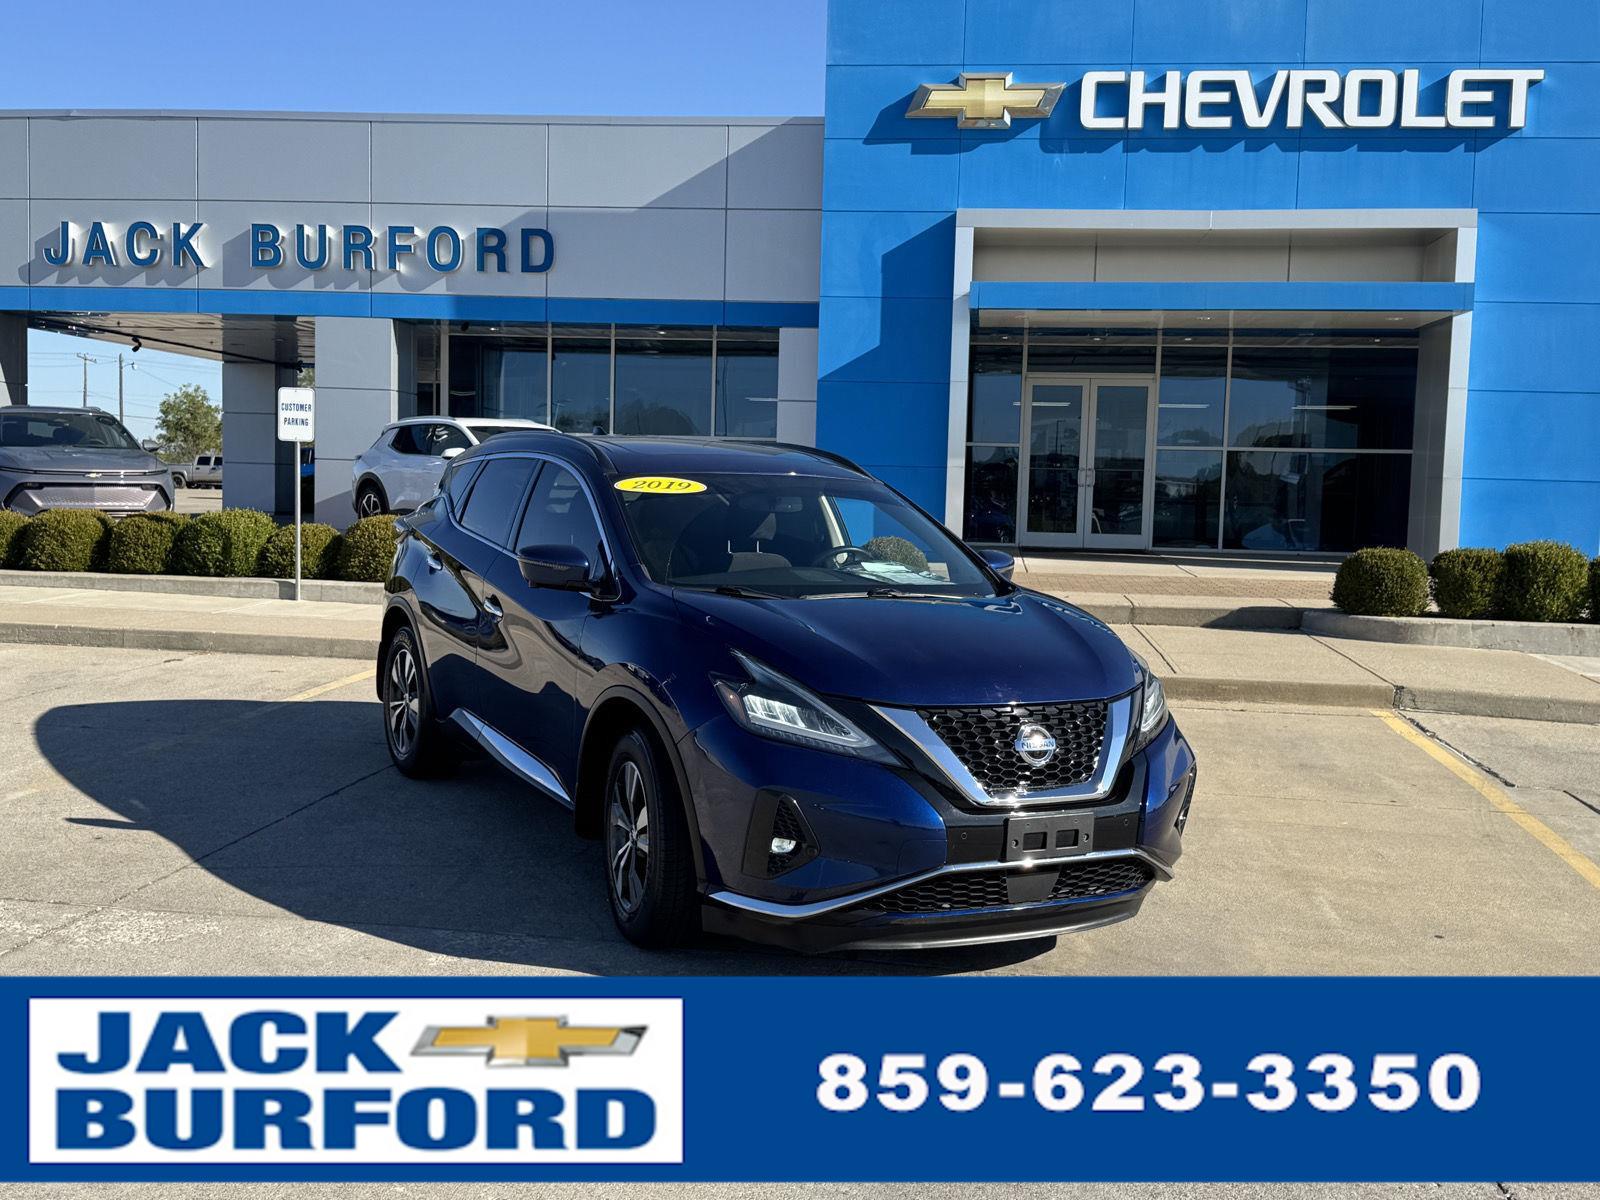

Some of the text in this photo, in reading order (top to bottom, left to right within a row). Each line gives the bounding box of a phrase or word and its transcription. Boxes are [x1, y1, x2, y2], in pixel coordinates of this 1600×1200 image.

[1080, 69, 1545, 129] CHEVROLET
[43, 221, 555, 273] JACK BURFORD
[281, 402, 312, 412] CUSTOMER
[283, 417, 309, 426] PARKING
[632, 480, 692, 491] 2019
